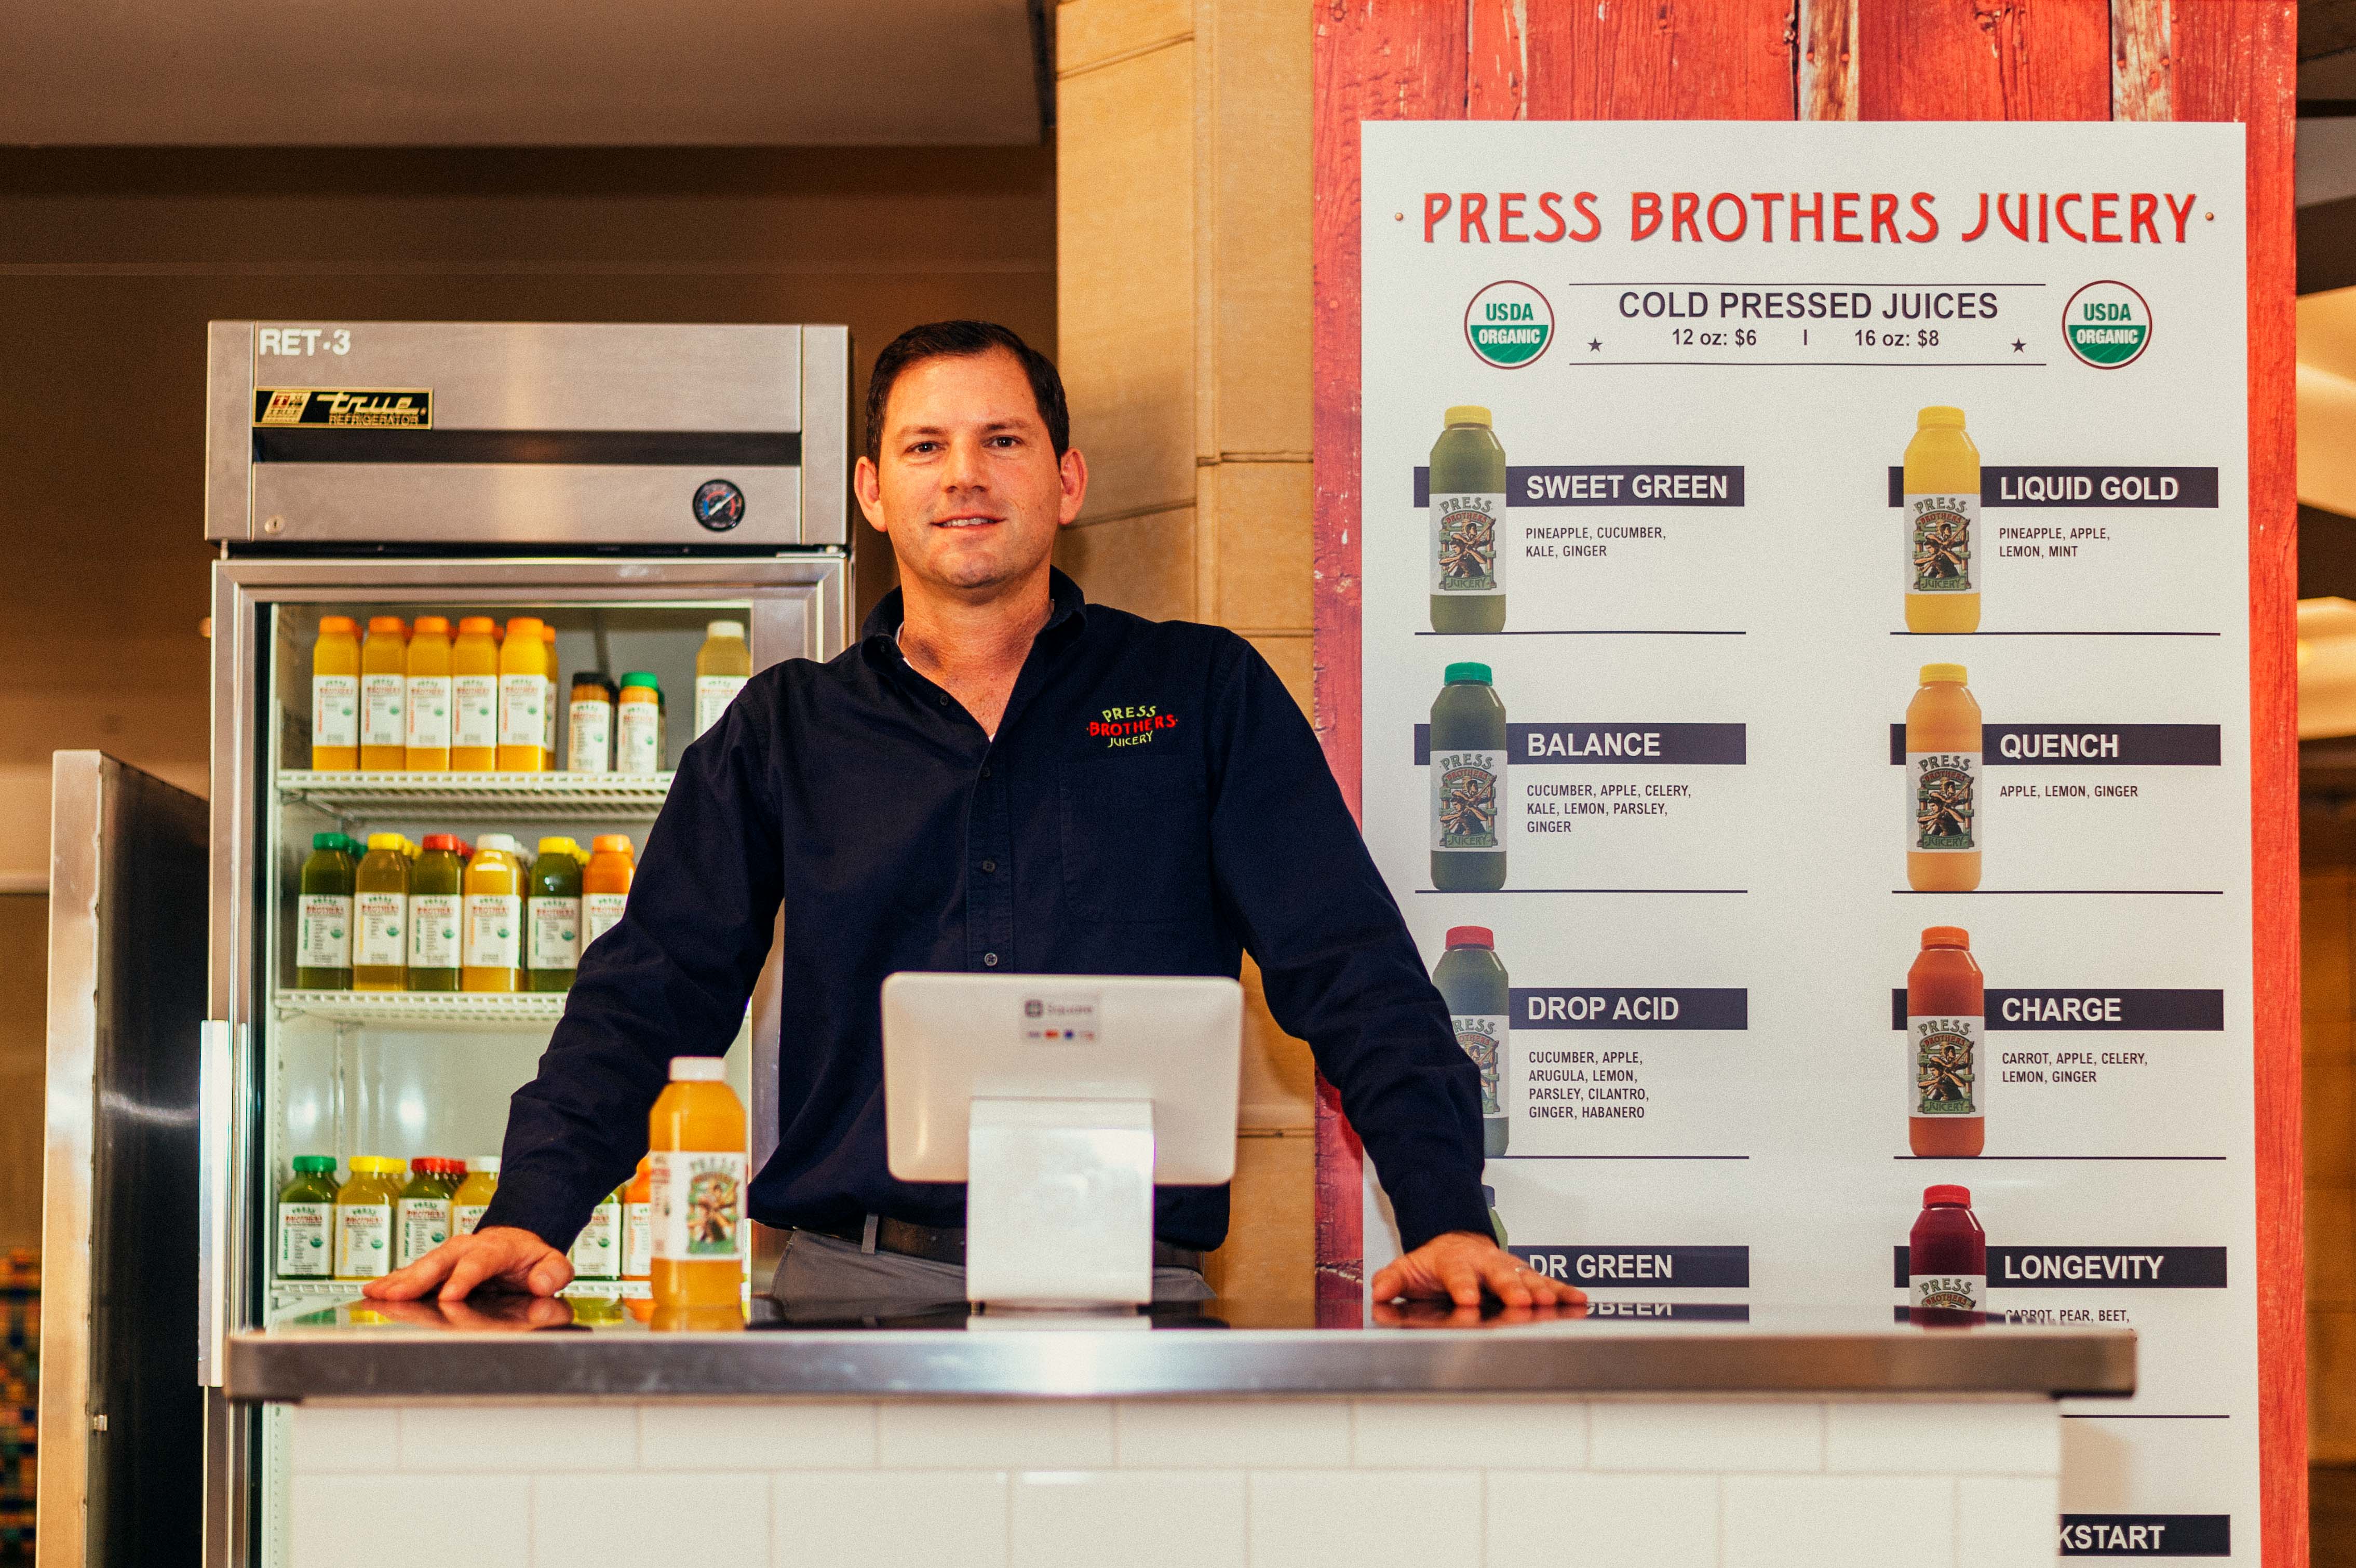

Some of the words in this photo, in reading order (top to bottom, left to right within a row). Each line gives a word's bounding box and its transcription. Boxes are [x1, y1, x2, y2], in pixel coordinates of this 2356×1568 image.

[1423, 191, 1601, 244] PRESS
[1630, 191, 1938, 244] BROTHERS
[1961, 192, 2196, 244] JUICERY
[1486, 303, 1534, 321] USDA
[1619, 291, 1708, 318] COLD
[1720, 292, 1872, 319] PRESSED
[1882, 292, 1998, 319] JUICES
[2083, 303, 2132, 321] USDA
[1478, 328, 1541, 344] ORGANIC
[1672, 328, 1693, 345] 12
[1700, 331, 1728, 345] oz:
[1734, 328, 1757, 346] $6
[1854, 330, 1876, 346] 16
[1882, 333, 1910, 347] oz:
[1918, 329, 1940, 348] $8
[2076, 328, 2139, 345] ORGANIC
[329, 414, 419, 426] REFRIGERATOR
[1526, 474, 1624, 499] SWEET
[1632, 474, 1727, 499] GREEN
[2000, 476, 2093, 502] LIQUID
[2100, 476, 2179, 501] GOLD
[1439, 497, 1492, 513] PRESS
[1914, 497, 1967, 514] PRESS
[1446, 512, 1487, 524] BROTHERS
[1920, 512, 1962, 524] BROTHERS
[1526, 528, 1593, 540] PINEAPPLE,
[1597, 526, 1666, 540] CUCUMBER,
[1999, 528, 2066, 540] PINEAPPLE,
[2070, 528, 2110, 540] APPLE,
[1526, 545, 1558, 559] KALE,
[1563, 545, 1607, 557] GINGER
[1999, 546, 2044, 559] LEMON,
[2049, 546, 2078, 557] MINT
[1448, 577, 1486, 589] JUICERY
[1923, 577, 1961, 589] JUICERY
[1102, 705, 1156, 723] PRESS
[1089, 714, 1177, 737] BROTHERS
[1107, 729, 1154, 748] JUICERY
[1527, 733, 1661, 756] BALANCE
[2000, 733, 2119, 759] QUENCH
[1440, 753, 1493, 771] PRESS
[1918, 755, 1971, 772] PRESS
[1446, 769, 1488, 781] BROTHERS
[1924, 770, 1965, 782] BROTHERS
[1526, 785, 1597, 799] CUCUMBER,
[1600, 785, 1641, 798] APPLE,
[1645, 784, 1691, 798] CELERY,
[2000, 785, 2041, 799] APPLE,
[2045, 785, 2090, 799] LEMON,
[2094, 785, 2138, 797] GINGER
[1527, 803, 1559, 817] KALE,
[1564, 803, 1609, 817] LEMON,
[1613, 803, 1667, 817] PARSLEY,
[1527, 821, 1572, 833] GINGER
[1450, 834, 1487, 846] JUICERY
[1927, 836, 1963, 848] JUICERY
[1528, 996, 1607, 1021] DROP
[1612, 996, 1679, 1021] ACID
[2001, 997, 2122, 1022] CHARGE
[1453, 1018, 1495, 1035] RESS
[1917, 1019, 1970, 1036] PRESS
[1459, 1034, 1490, 1045] OTHERS
[1924, 1034, 1965, 1047] BROTHERS
[1528, 1051, 1598, 1065] CUCUMBER,
[1602, 1051, 1643, 1064] APPLE,
[2002, 1052, 2052, 1066] CARROT,
[2056, 1052, 2097, 1066] APPLE,
[2101, 1052, 2148, 1066] CELERY,
[1528, 1070, 1588, 1083] ARUGULA,
[1592, 1070, 1637, 1083] LEMON,
[2002, 1071, 2048, 1085] LEMON,
[2052, 1071, 2097, 1083] GINGER
[1528, 1088, 1584, 1102] PARSLEY,
[1588, 1088, 1649, 1102] CILANTRO,
[1529, 1106, 1577, 1120] GINGER,
[1582, 1106, 1645, 1118] HABANERO
[1927, 1100, 1965, 1112] JUICERY
[1529, 1254, 1568, 1278] DR
[1576, 1254, 1673, 1279] GREEN
[2004, 1254, 2164, 1280] LONGEVITY
[1919, 1278, 1972, 1295] PRESS
[1926, 1293, 1967, 1306] BROTHERS
[2060, 1309, 2094, 1323] PEAR,
[2098, 1309, 2130, 1323] BEET,
[2058, 1525, 2165, 1549] KSTART
